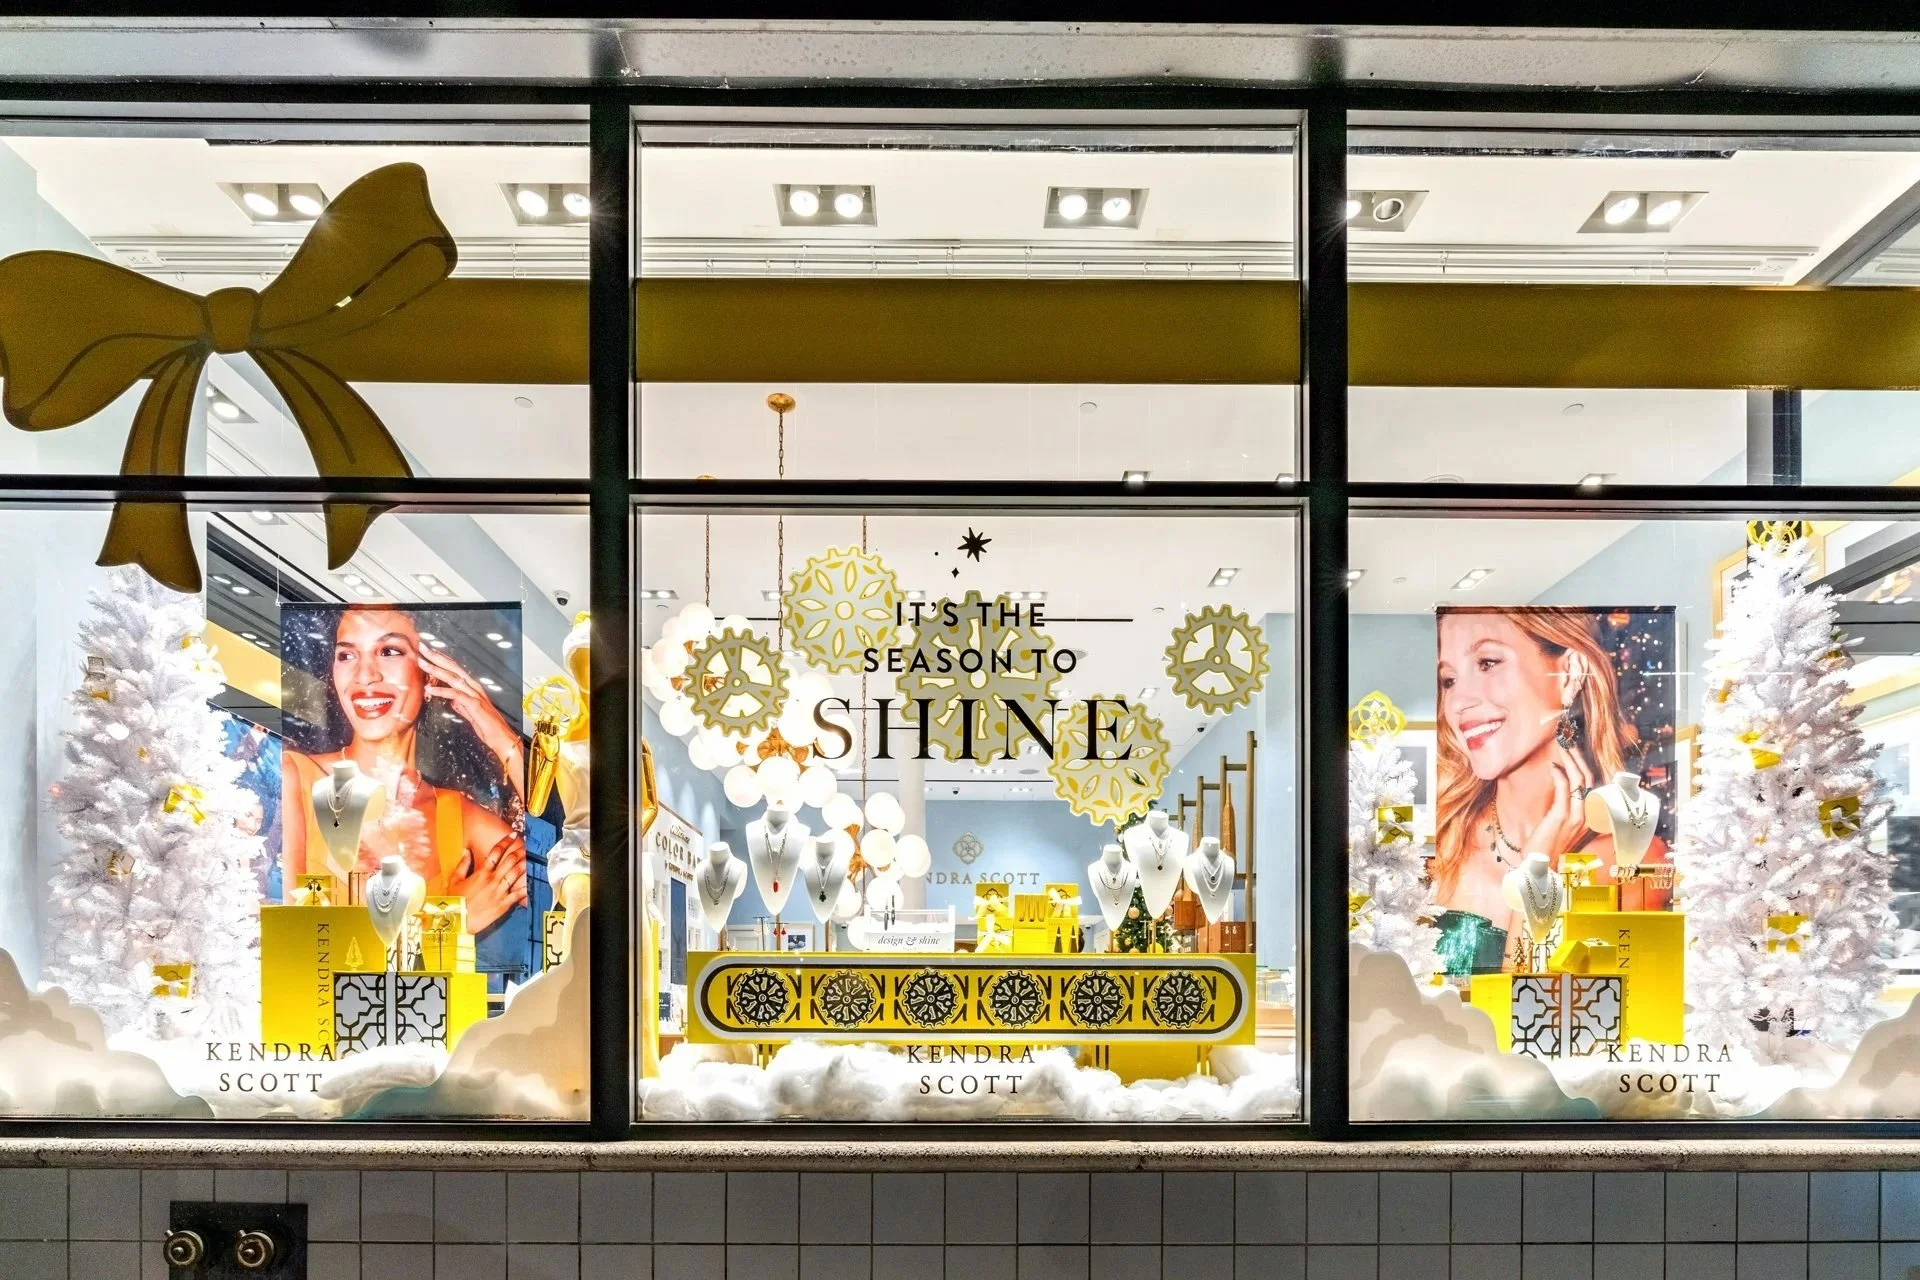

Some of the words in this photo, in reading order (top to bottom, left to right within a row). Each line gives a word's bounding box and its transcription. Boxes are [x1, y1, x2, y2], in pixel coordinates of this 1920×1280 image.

[896, 602, 958, 627] IT’S
[977, 603, 1046, 627] THE
[863, 648, 1012, 673] SEASON
[1031, 648, 1078, 673] TO
[812, 697, 1134, 760] SHINE
[655, 832, 684, 861] COLOR
[926, 872, 972, 885] NDRA
[979, 872, 1040, 885] SCOTT
[877, 936, 904, 946] design
[905, 936, 918, 946] &
[918, 936, 941, 945] shine
[317, 923, 330, 1007] KENDRA
[206, 1042, 336, 1061] KENDRA
[906, 1044, 1036, 1064] KENDRA
[1607, 1043, 1732, 1062] KENDRA
[219, 1072, 322, 1092] SCOTT
[919, 1074, 1022, 1094] SCOTT
[1619, 1073, 1720, 1093] SCOTT
